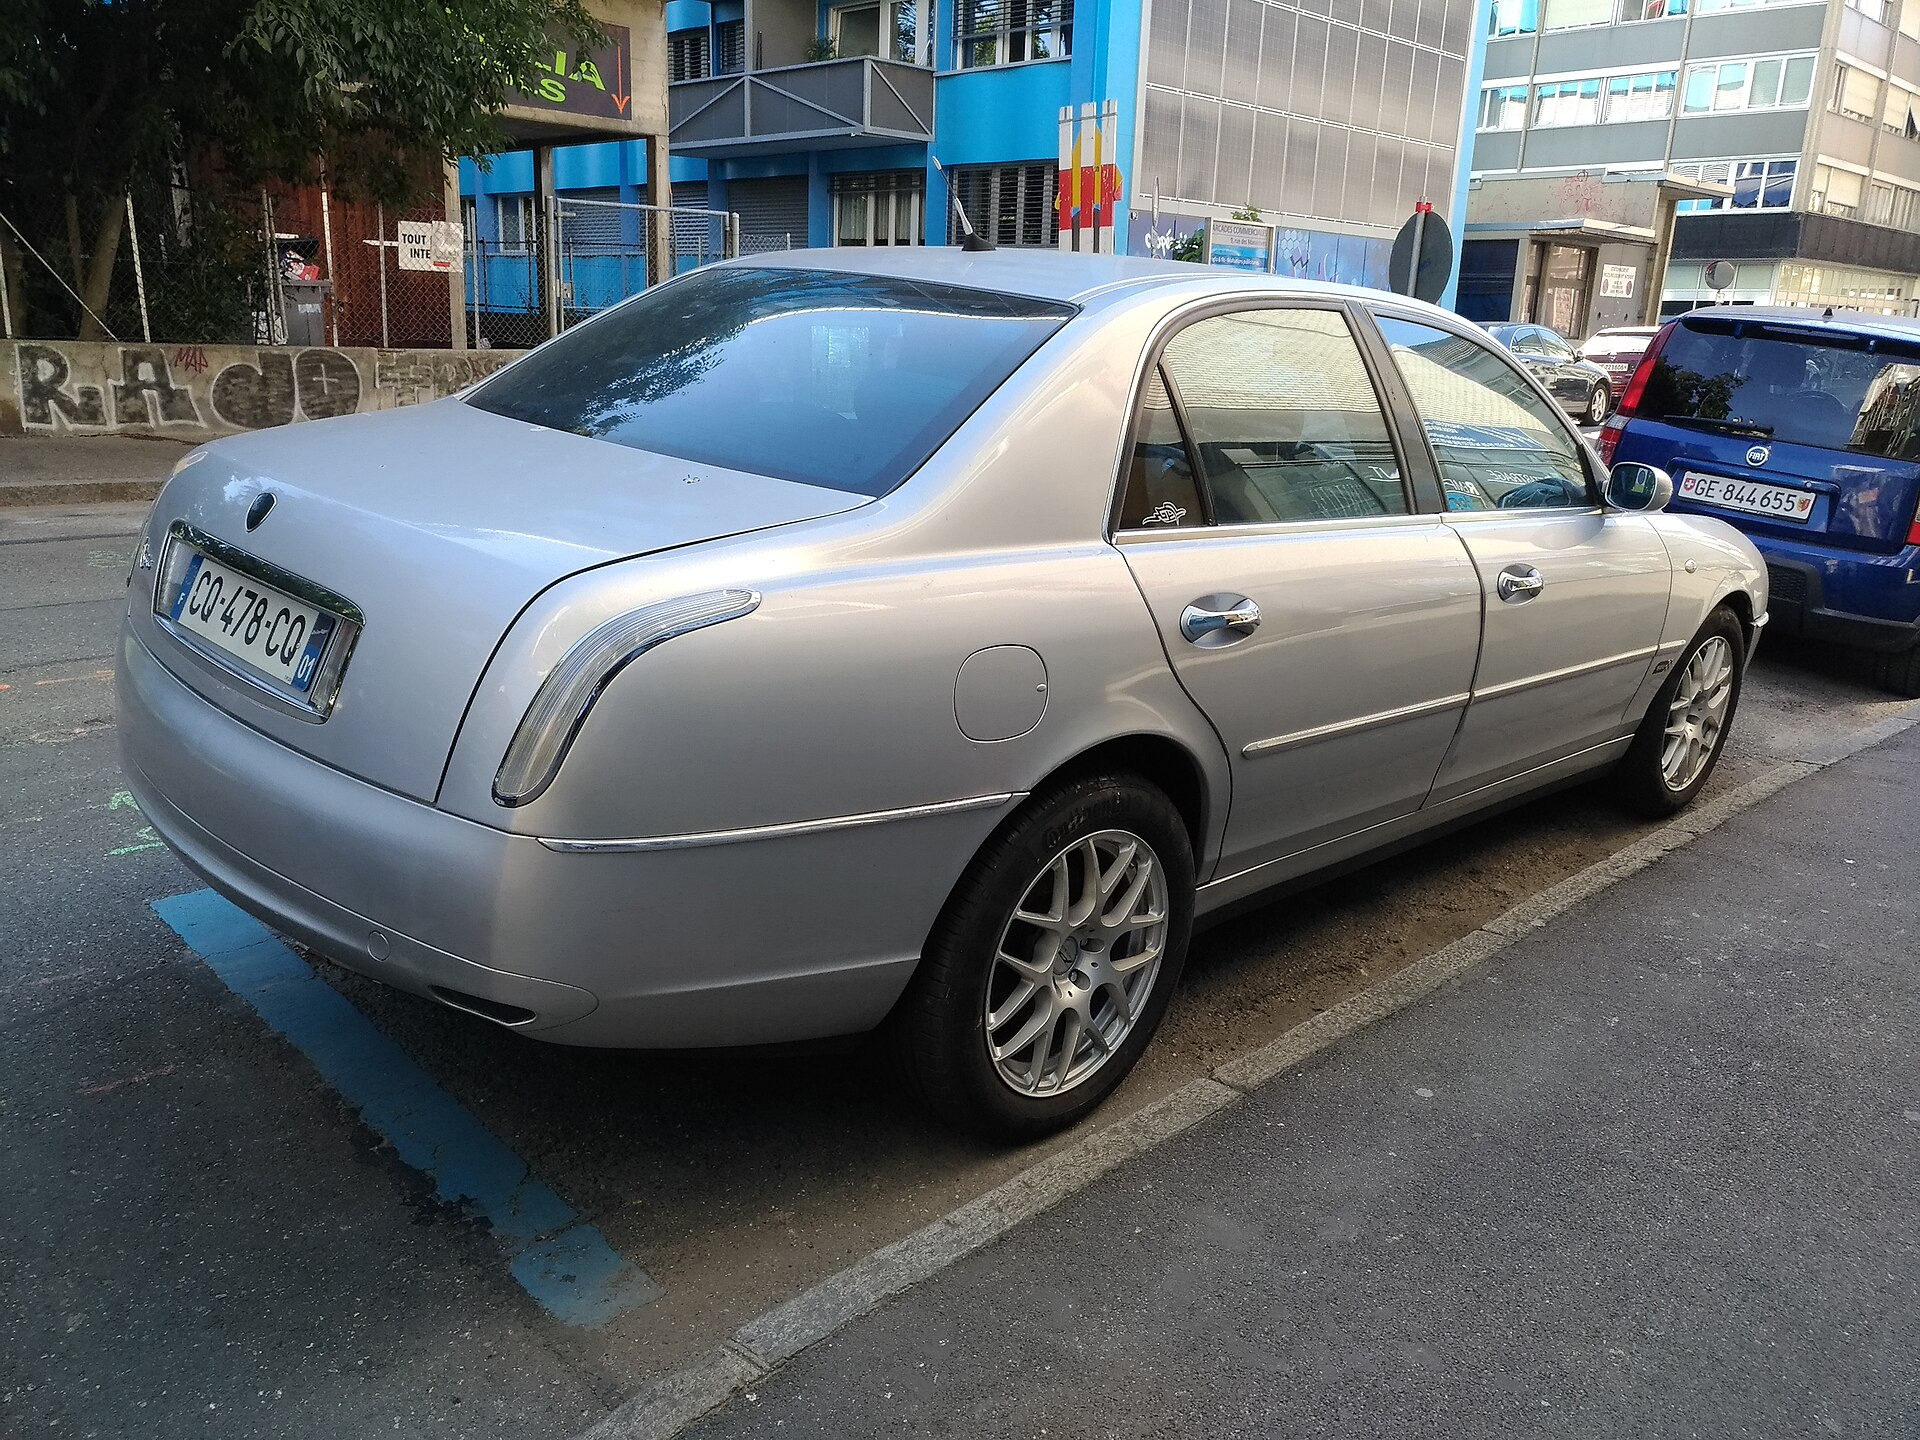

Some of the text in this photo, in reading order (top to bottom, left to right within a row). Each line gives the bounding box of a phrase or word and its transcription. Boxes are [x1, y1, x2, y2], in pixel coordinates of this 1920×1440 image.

[402, 233, 427, 245] TOUT
[410, 248, 431, 259] INTE
[1748, 451, 1765, 461] FIAT
[177, 592, 186, 604] F
[297, 654, 316, 682] 01
